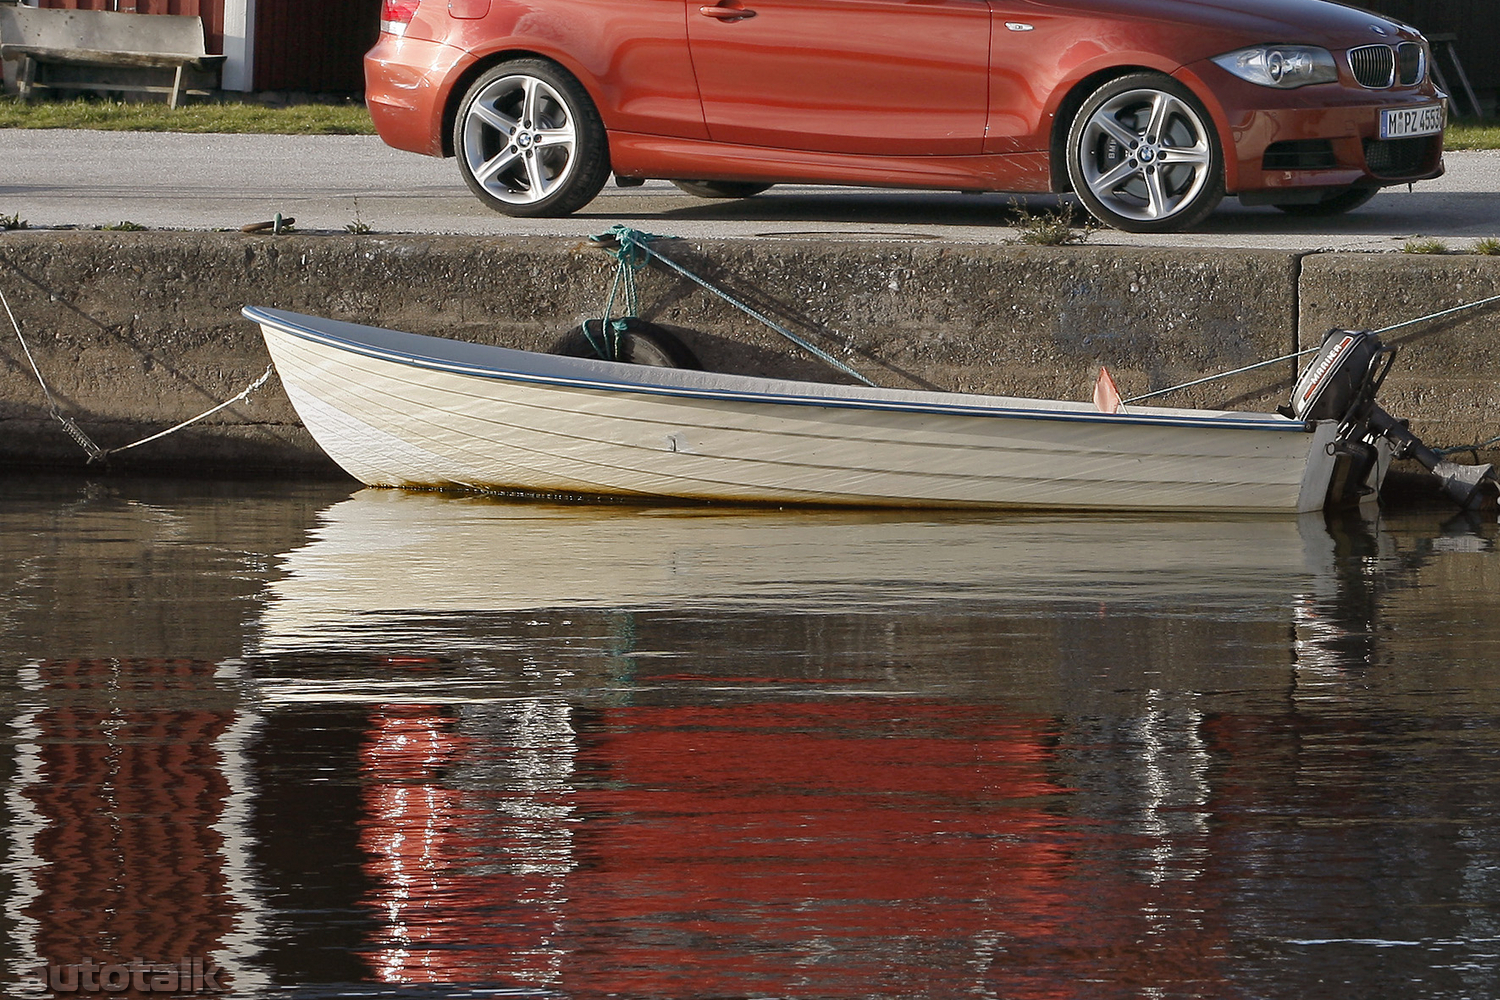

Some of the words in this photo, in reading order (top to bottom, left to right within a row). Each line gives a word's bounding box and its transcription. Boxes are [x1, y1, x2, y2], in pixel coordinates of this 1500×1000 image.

[1389, 113, 1397, 134] M
[1404, 111, 1418, 133] PZ
[1310, 344, 1343, 385] MARINER
